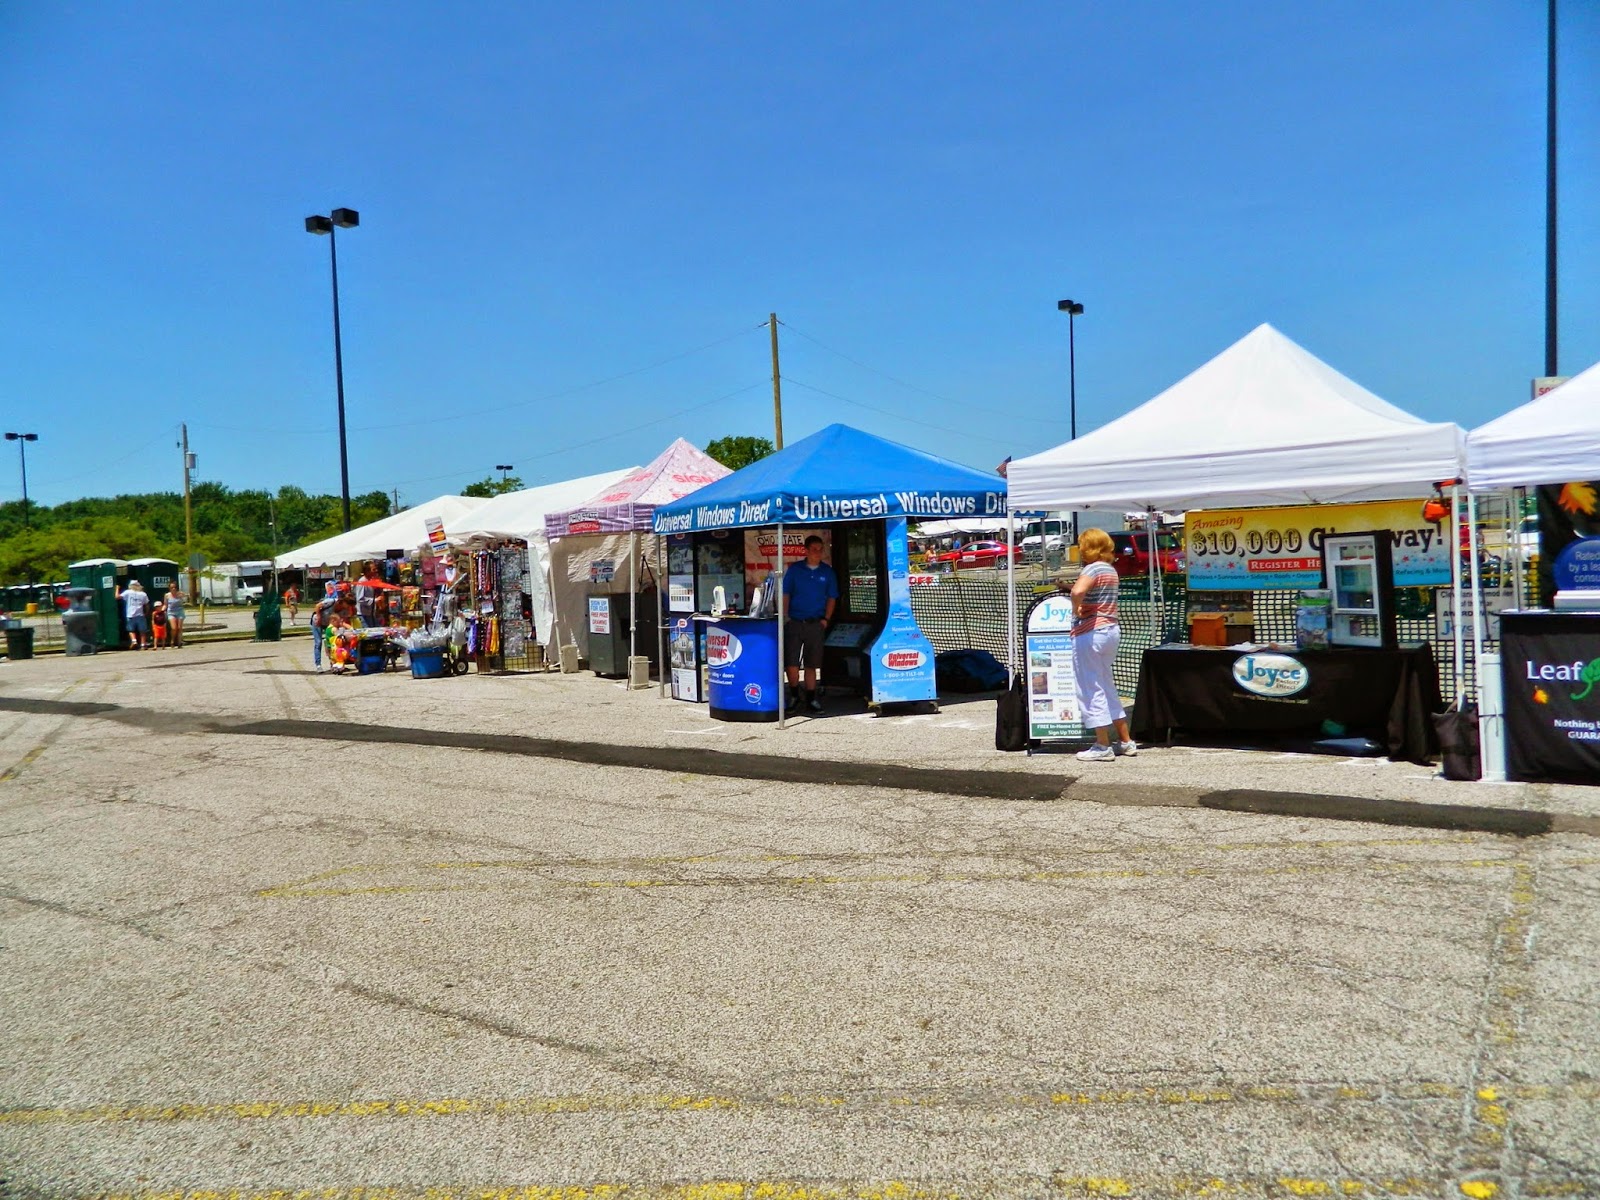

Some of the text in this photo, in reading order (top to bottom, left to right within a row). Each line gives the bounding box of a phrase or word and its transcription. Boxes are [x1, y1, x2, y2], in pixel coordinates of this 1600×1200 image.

[672, 474, 713, 483] SIGN
[794, 493, 888, 520] Universal
[894, 491, 976, 515] Windows
[655, 499, 770, 532] Universal Windows Direct
[1192, 516, 1244, 530] Amazing
[757, 535, 776, 546] OHIO
[1191, 528, 1302, 557] $10,000
[1568, 562, 1580, 573] by
[1582, 564, 1588, 572] a
[1250, 572, 1269, 581] Siding
[888, 651, 919, 660] Universal
[888, 659, 918, 668] Windows
[1240, 656, 1302, 688] Joyce
[1553, 719, 1595, 730] Nothing
